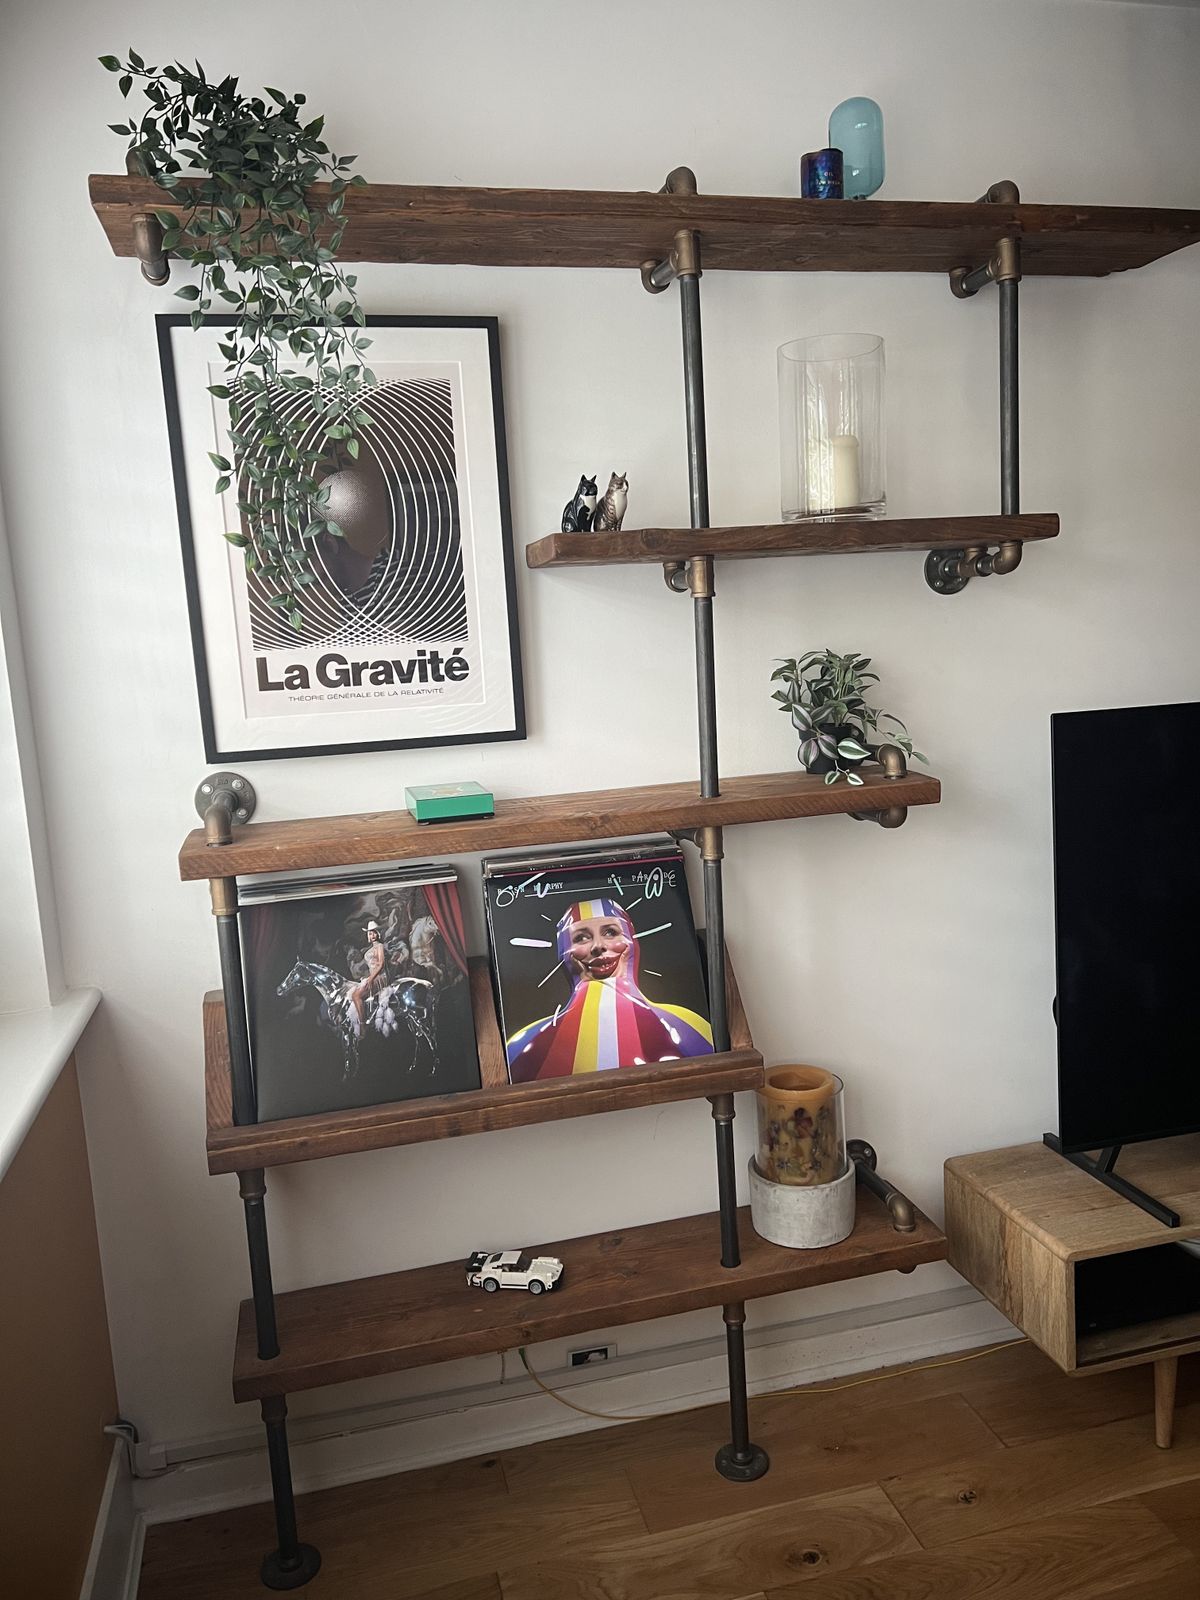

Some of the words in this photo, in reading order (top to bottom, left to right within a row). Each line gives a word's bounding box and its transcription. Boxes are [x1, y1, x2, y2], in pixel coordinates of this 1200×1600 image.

[255, 656, 310, 692] La
[315, 647, 470, 688] Gravité
[288, 694, 324, 702] THÉORIE
[327, 691, 371, 700] GÉNÉRALE
[401, 687, 444, 696] RELATIVITÉ
